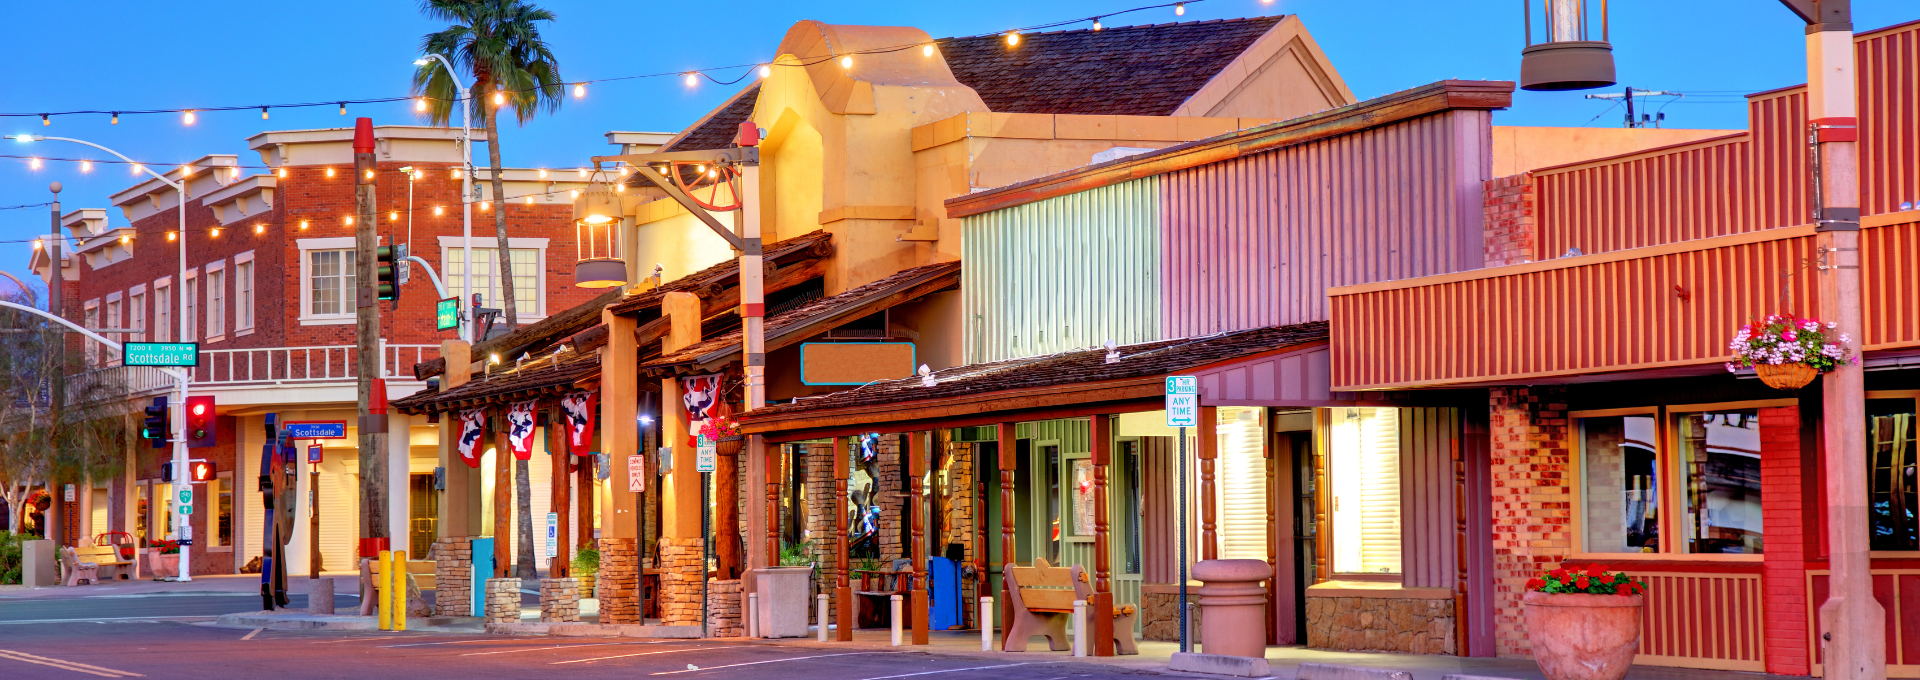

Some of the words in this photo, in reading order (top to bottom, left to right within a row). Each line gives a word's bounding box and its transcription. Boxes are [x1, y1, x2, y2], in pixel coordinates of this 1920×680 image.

[129, 353, 180, 364] Scottsdale
[1168, 380, 1175, 392] 3
[1172, 397, 1191, 405] ANY
[1172, 407, 1191, 415] TIME
[295, 429, 336, 437] Scottsdale
[699, 436, 703, 446] 3
